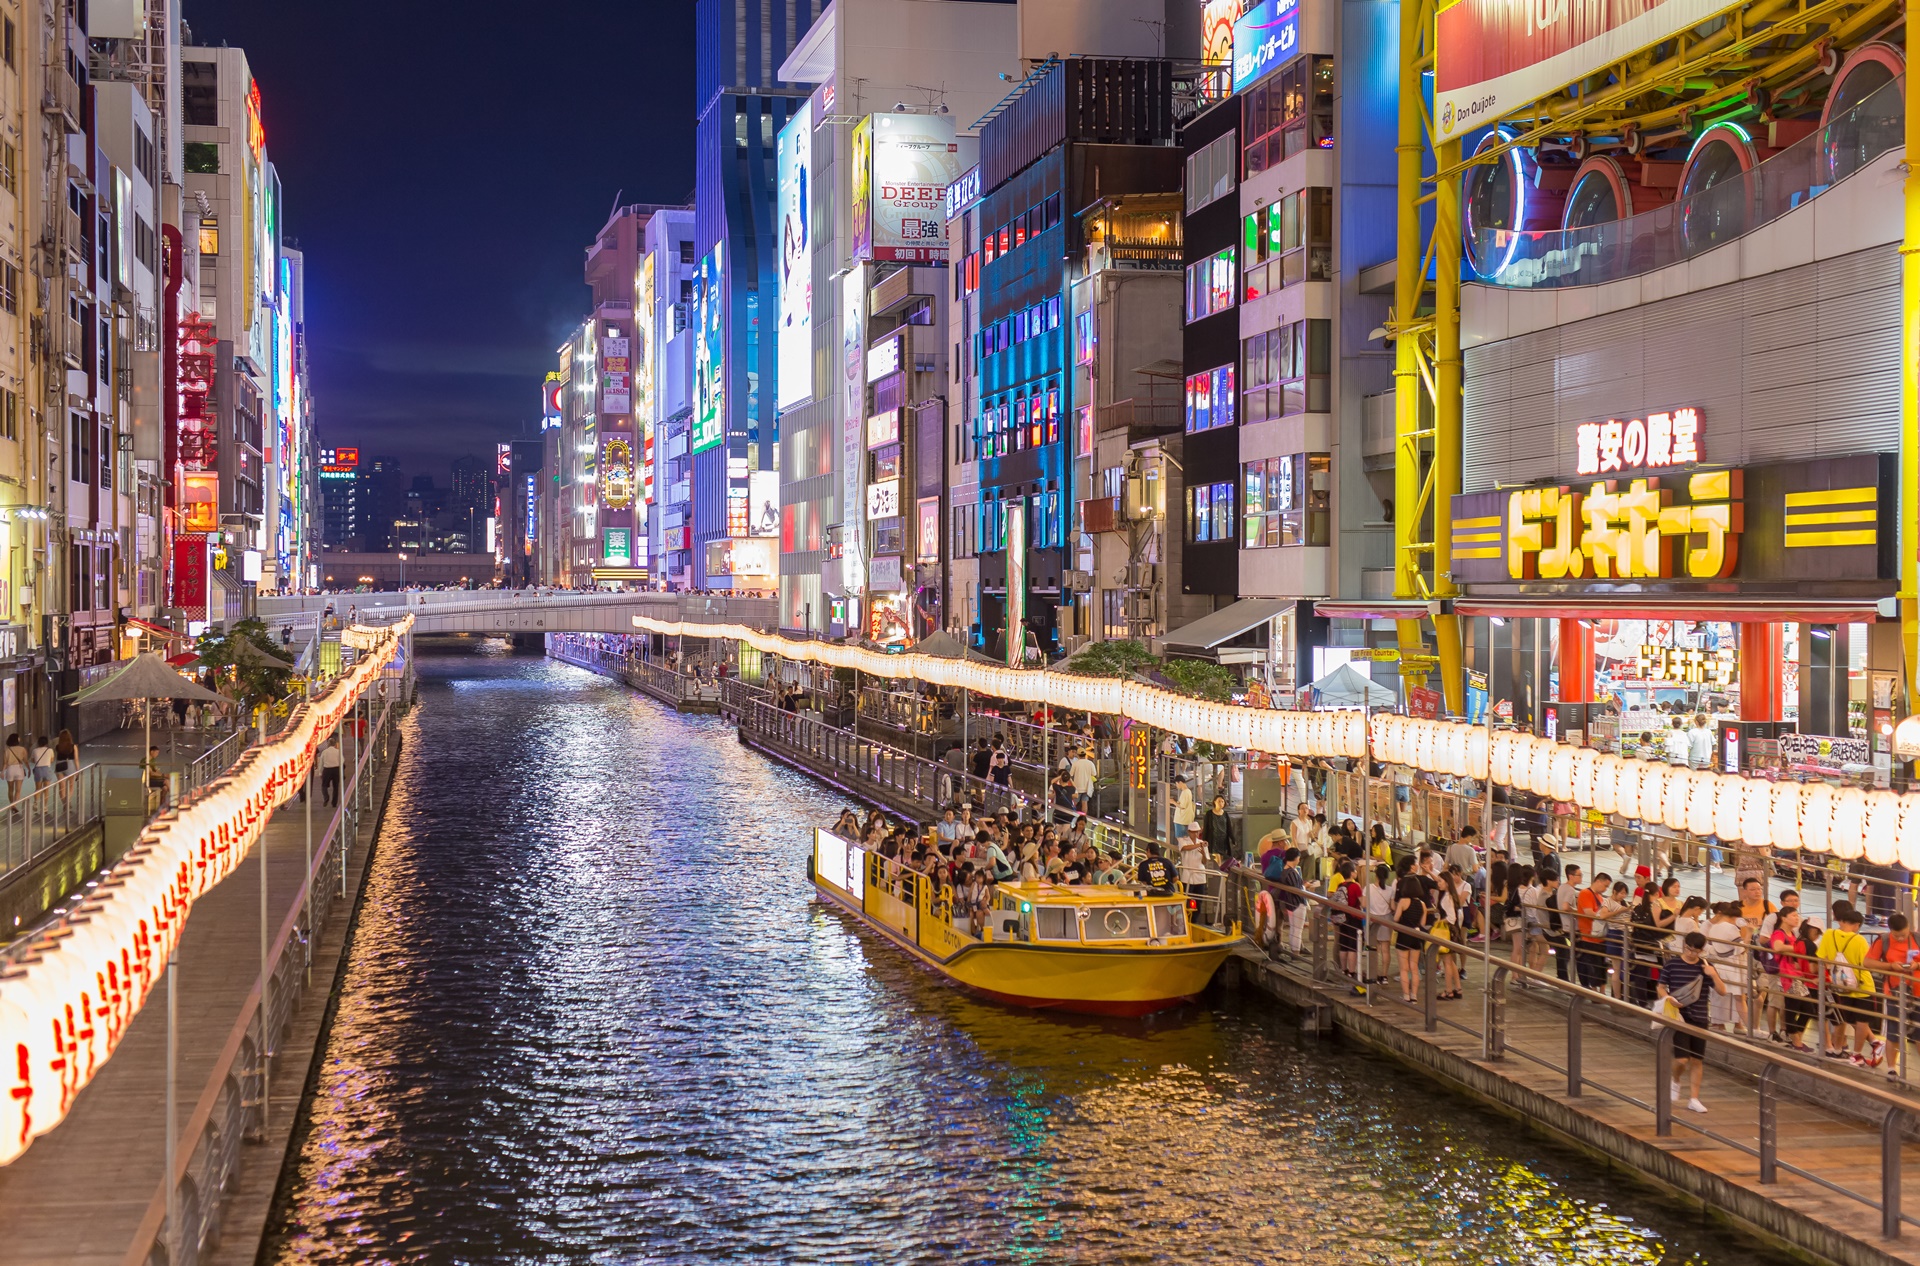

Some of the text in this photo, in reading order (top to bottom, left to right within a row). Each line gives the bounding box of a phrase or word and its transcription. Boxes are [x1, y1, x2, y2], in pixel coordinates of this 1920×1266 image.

[1457, 94, 1496, 122] Don Quijote
[881, 186, 947, 201] DEEP
[893, 200, 938, 210] Group
[902, 219, 939, 239] 最強
[1576, 407, 1699, 476] 驚安の殿堂
[609, 531, 626, 548] 薬
[923, 518, 935, 544] G3
[187, 544, 199, 598] 大阪みやげ
[495, 619, 544, 628] えびす橋
[1360, 649, 1372, 657] Free
[1374, 649, 1396, 657] Counter
